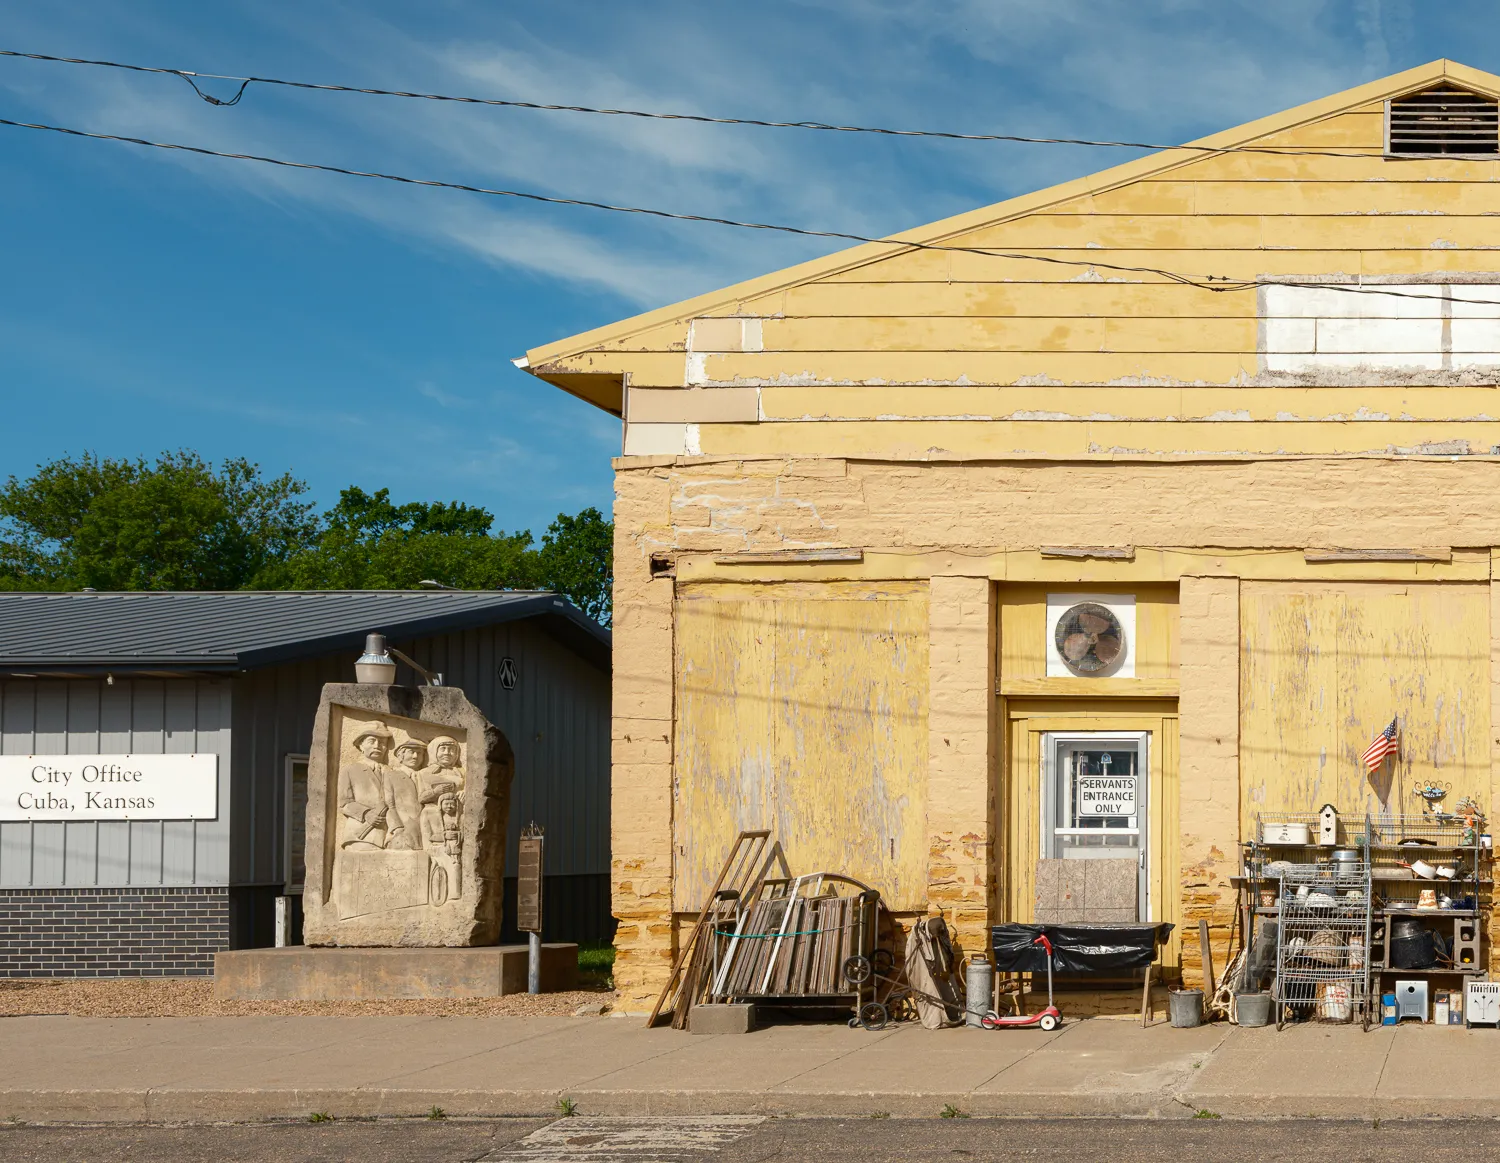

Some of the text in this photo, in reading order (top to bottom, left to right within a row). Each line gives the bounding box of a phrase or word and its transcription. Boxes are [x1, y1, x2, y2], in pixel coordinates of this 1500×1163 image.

[31, 764, 143, 787] City Office
[1083, 779, 1134, 789] SERVANTS
[1083, 791, 1134, 801] ENTRANCE
[17, 791, 155, 812] Cuba, Kansas
[1095, 804, 1122, 813] ONLY
